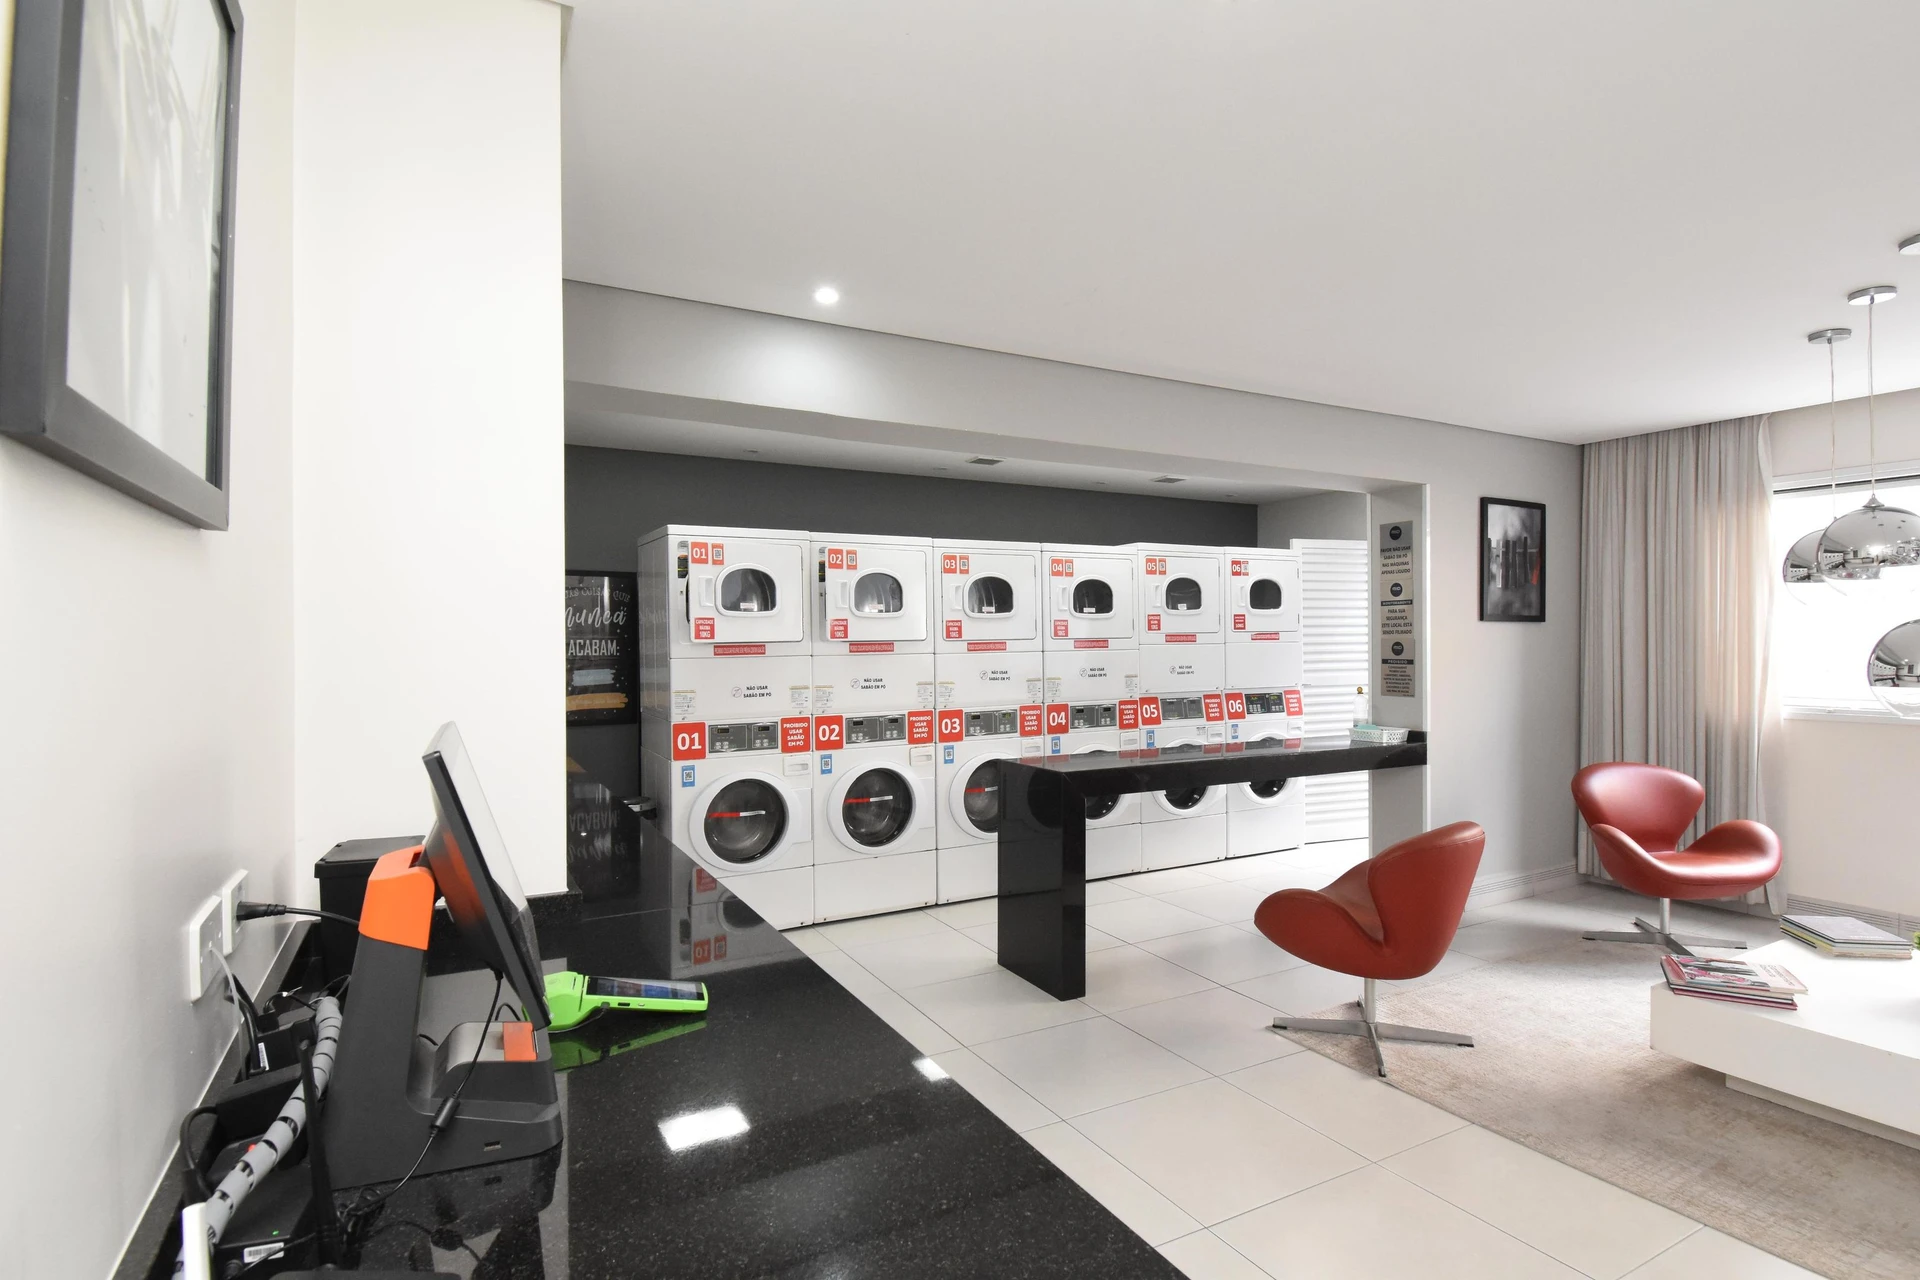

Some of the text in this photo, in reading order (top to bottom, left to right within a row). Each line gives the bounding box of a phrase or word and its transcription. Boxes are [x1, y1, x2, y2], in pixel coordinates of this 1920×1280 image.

[693, 547, 707, 559] 01
[829, 553, 842, 564] 02
[945, 559, 956, 569] 03
[1052, 563, 1063, 572] 04
[1147, 562, 1156, 571] 05
[1232, 564, 1241, 572] 06
[613, 590, 631, 602] QUE
[568, 639, 620, 656] ACABAM:
[1142, 704, 1158, 718] 05
[1228, 699, 1243, 713] 06
[1049, 711, 1066, 726] 04
[818, 724, 840, 741] 02
[941, 718, 960, 734] 03
[677, 732, 702, 751] 01
